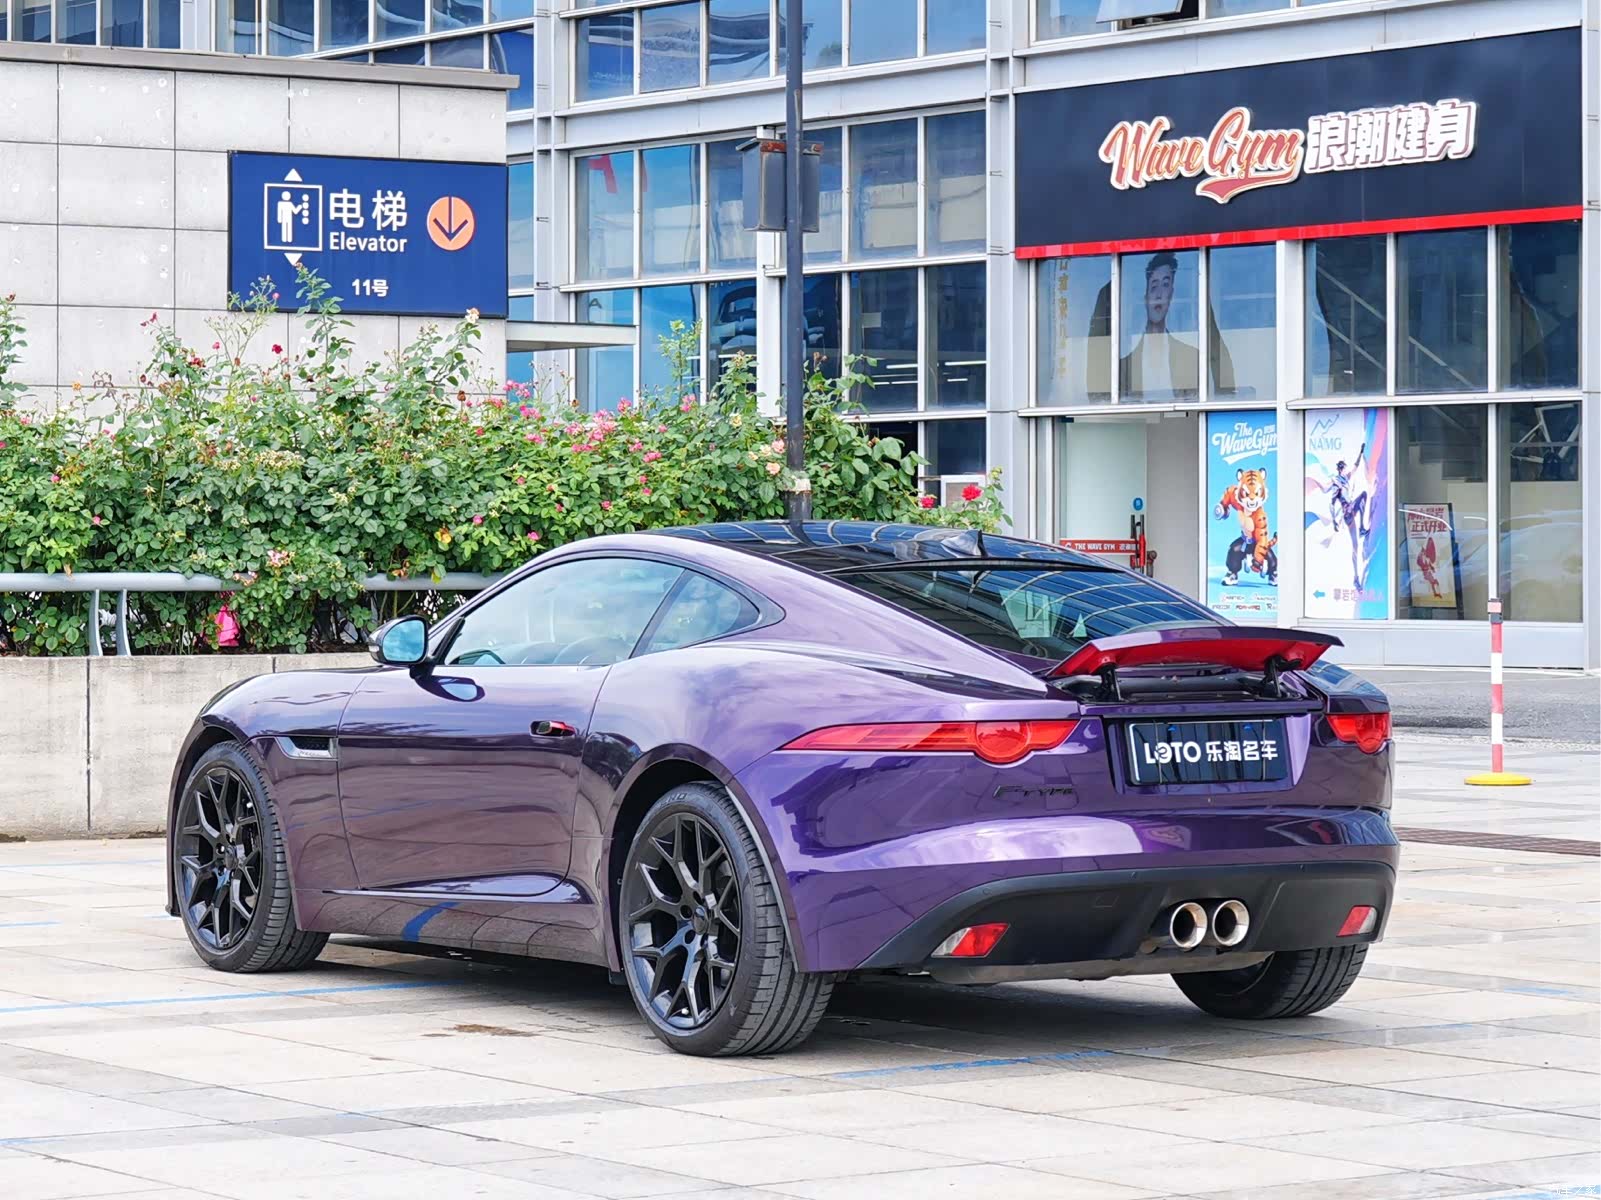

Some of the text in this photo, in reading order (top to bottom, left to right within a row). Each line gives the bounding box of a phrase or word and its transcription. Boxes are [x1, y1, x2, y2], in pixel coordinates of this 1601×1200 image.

[1303, 98, 1477, 174] 浪潮健身
[1098, 106, 1304, 199] Wave Gym
[329, 188, 408, 231] 电梯
[329, 231, 408, 253] Elevator
[351, 278, 389, 297] 11号
[1234, 422, 1253, 437] The
[1103, 542, 1116, 550] GYM
[1144, 741, 1201, 764] LOTO
[1205, 740, 1279, 762] 乐淘名车
